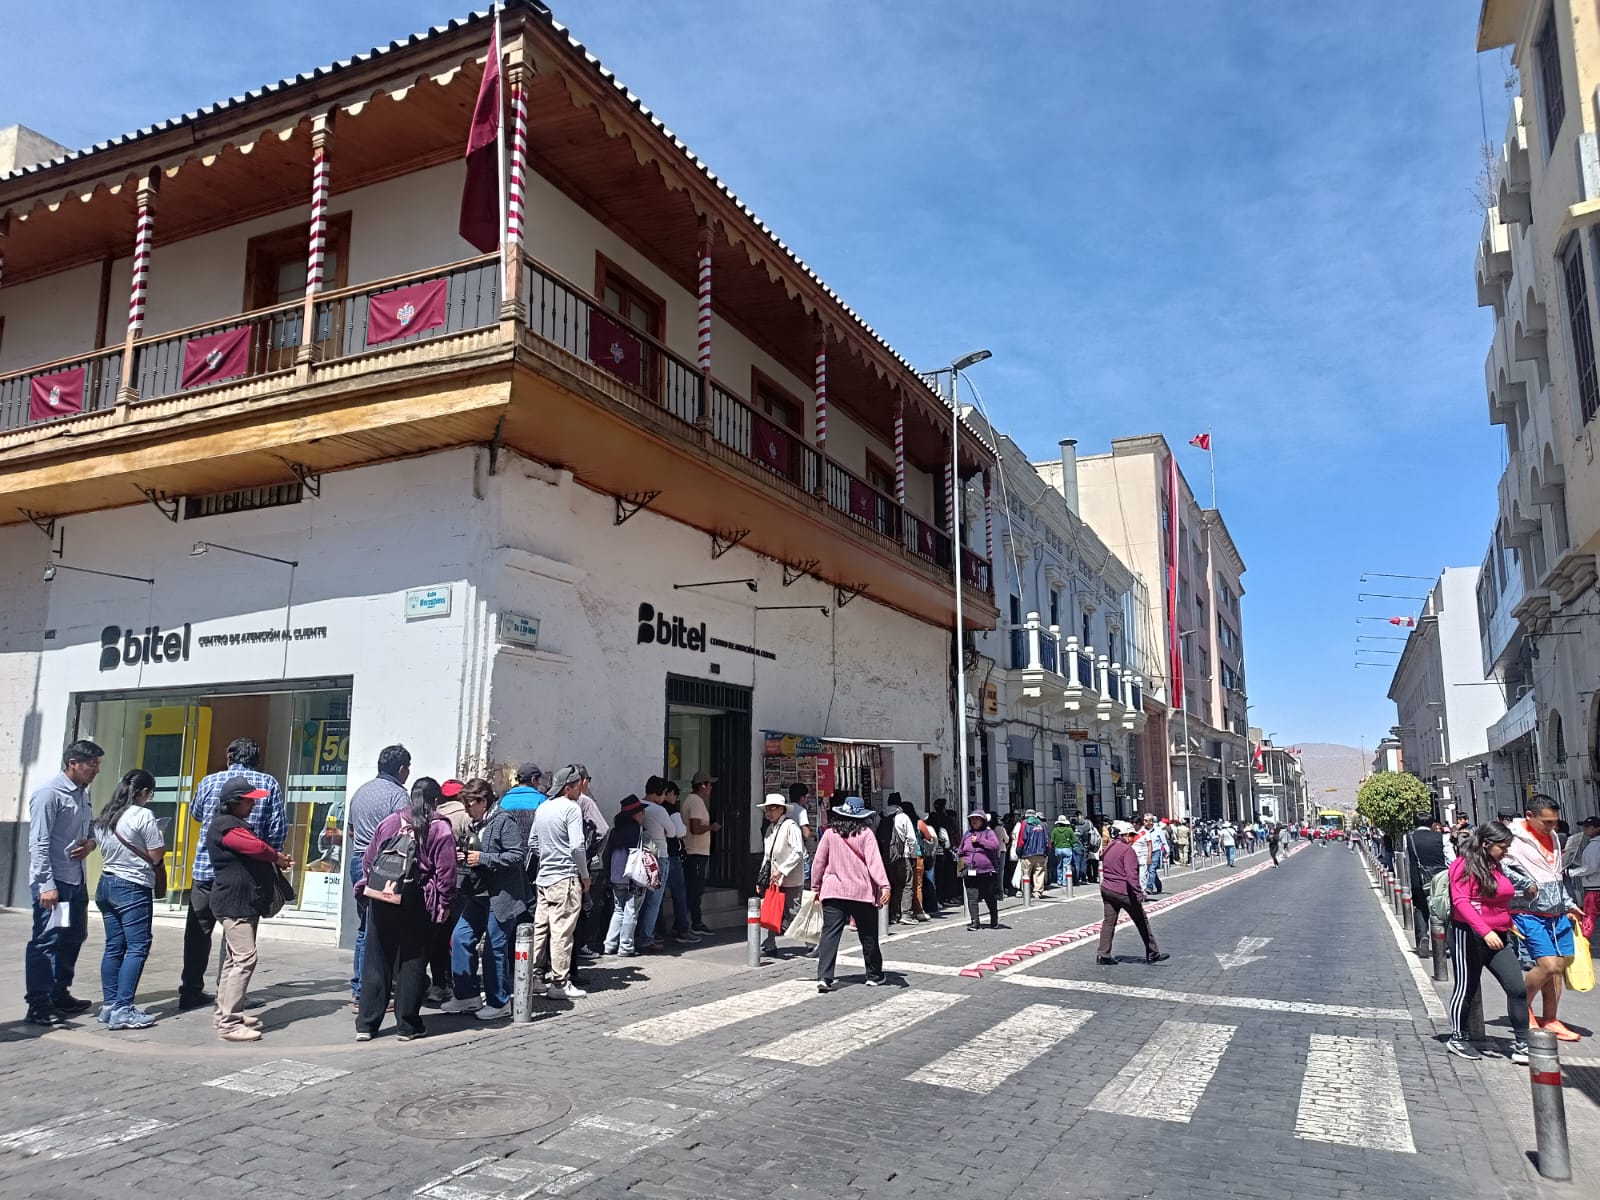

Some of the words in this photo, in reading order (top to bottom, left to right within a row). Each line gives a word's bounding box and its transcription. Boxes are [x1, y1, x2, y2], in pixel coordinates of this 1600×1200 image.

[122, 623, 191, 665] bitel
[198, 633, 228, 647] CENTRO
[229, 633, 240, 645] DE
[281, 630, 293, 641] AL
[293, 626, 327, 640] CLIENTE
[656, 612, 706, 653] bitel
